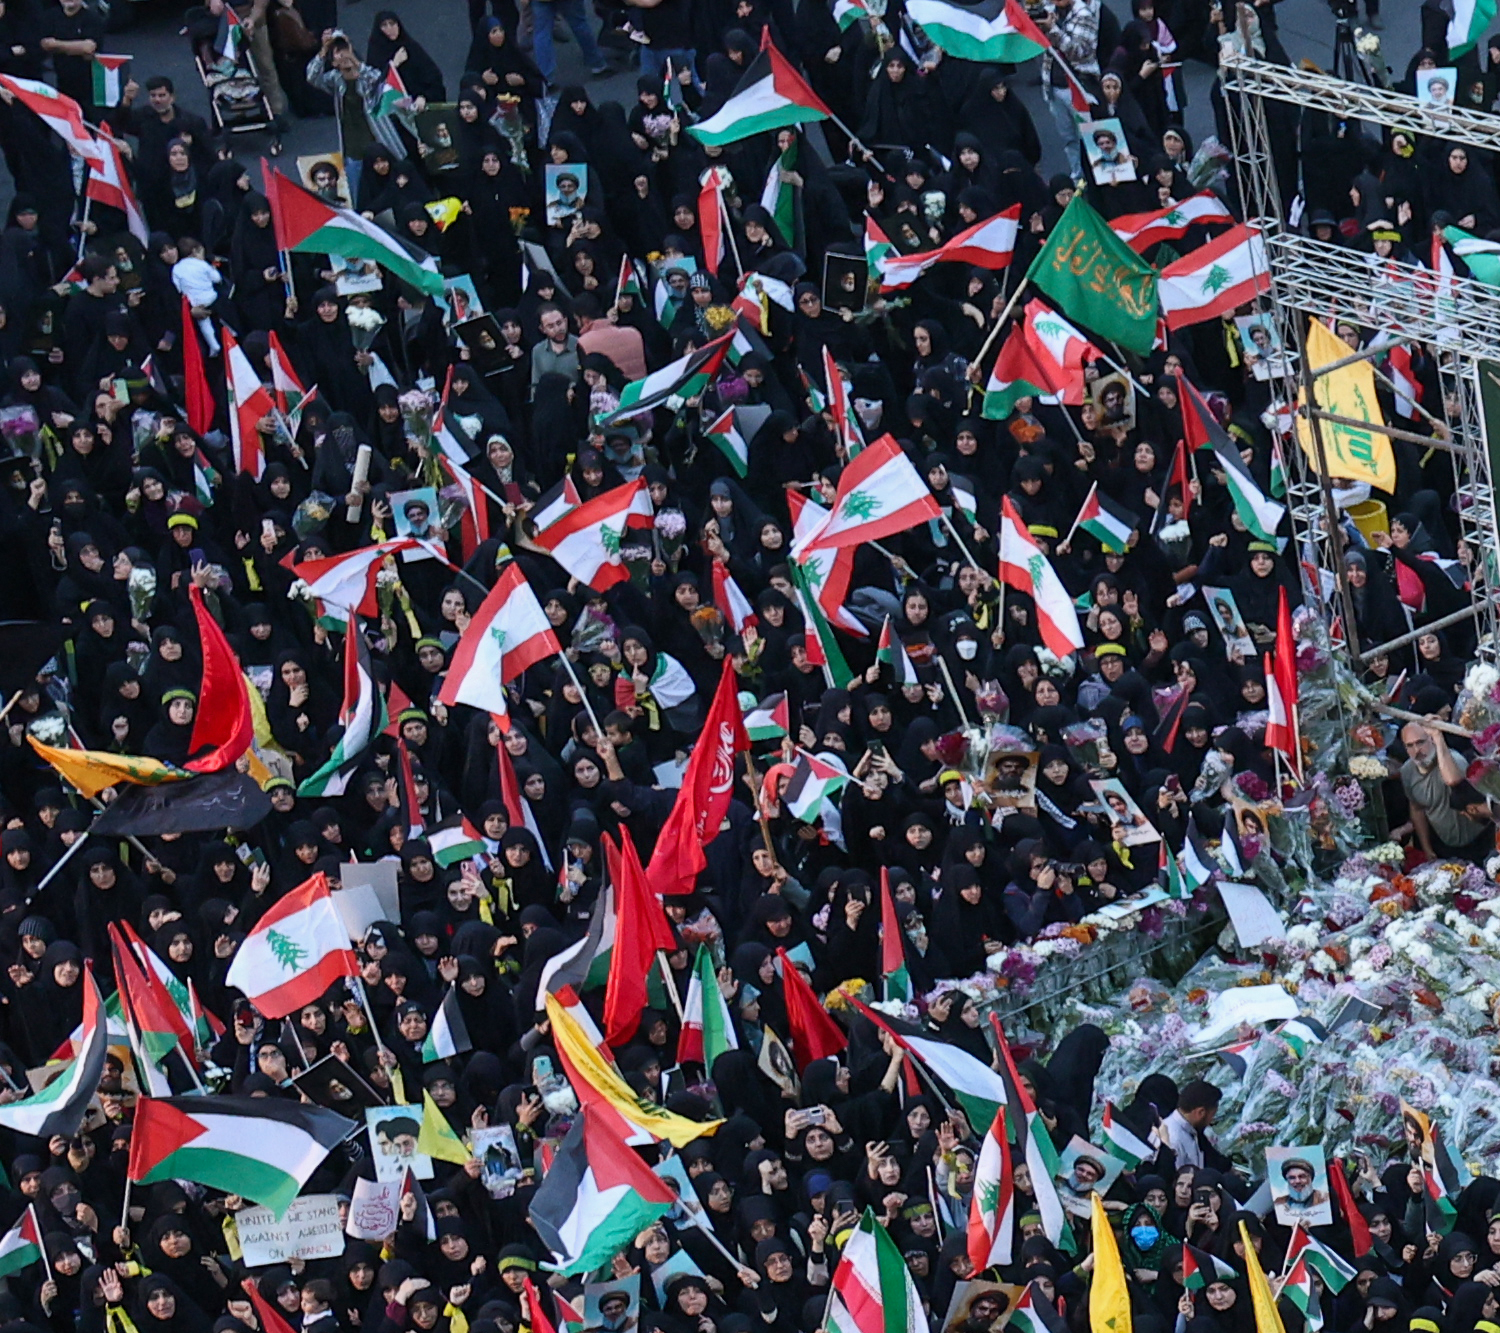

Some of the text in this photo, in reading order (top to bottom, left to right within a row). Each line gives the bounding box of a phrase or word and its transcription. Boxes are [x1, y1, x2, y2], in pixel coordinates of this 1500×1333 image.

[239, 1206, 337, 1228] UNITE WE STAND
[268, 1247, 285, 1260] ON
